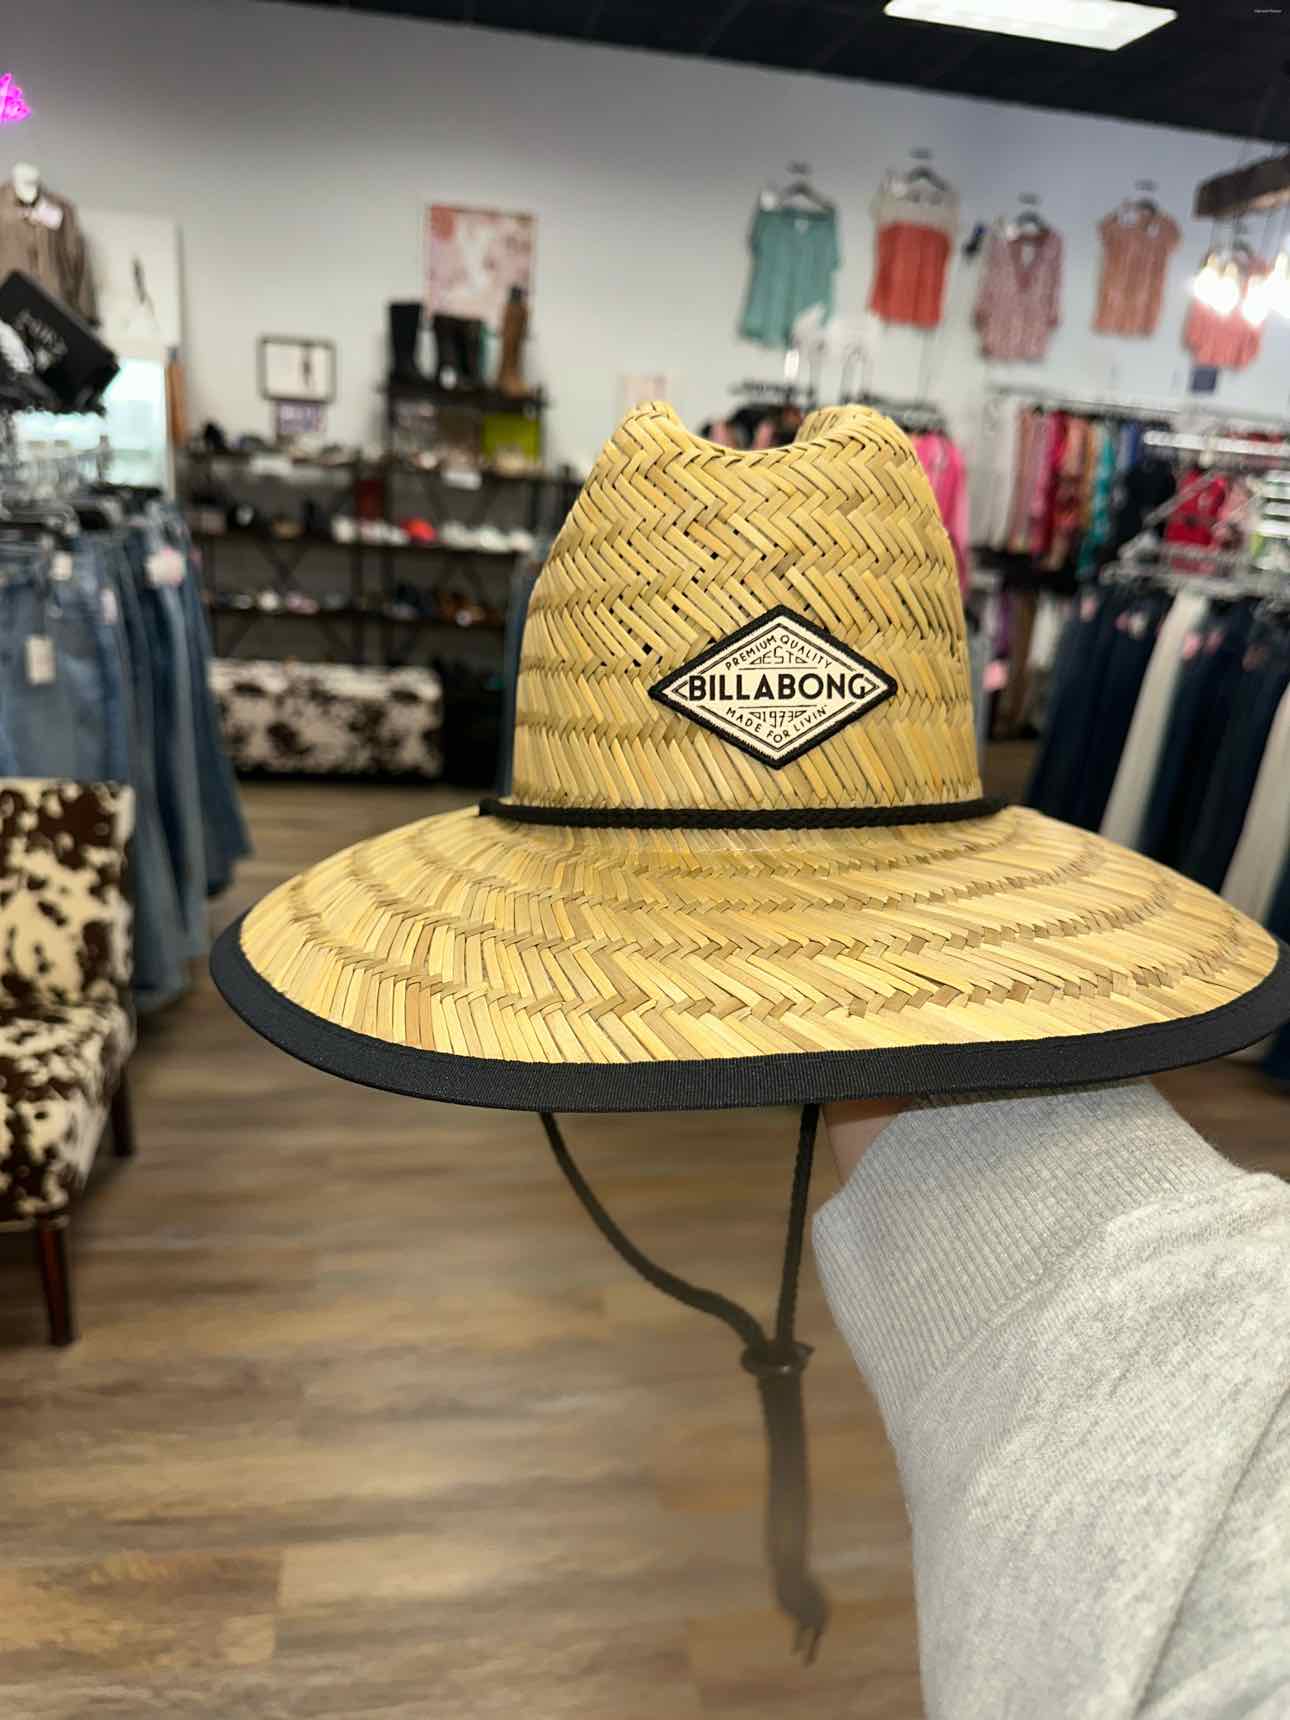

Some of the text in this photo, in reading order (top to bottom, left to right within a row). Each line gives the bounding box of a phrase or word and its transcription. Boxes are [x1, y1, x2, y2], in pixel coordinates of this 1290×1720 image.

[725, 634, 832, 670] PREMIUM QUALITY
[688, 673, 866, 701] BILLABONG
[725, 707, 762, 732] MADE
[766, 730, 790, 743] FOR
[762, 711, 794, 728] 1973
